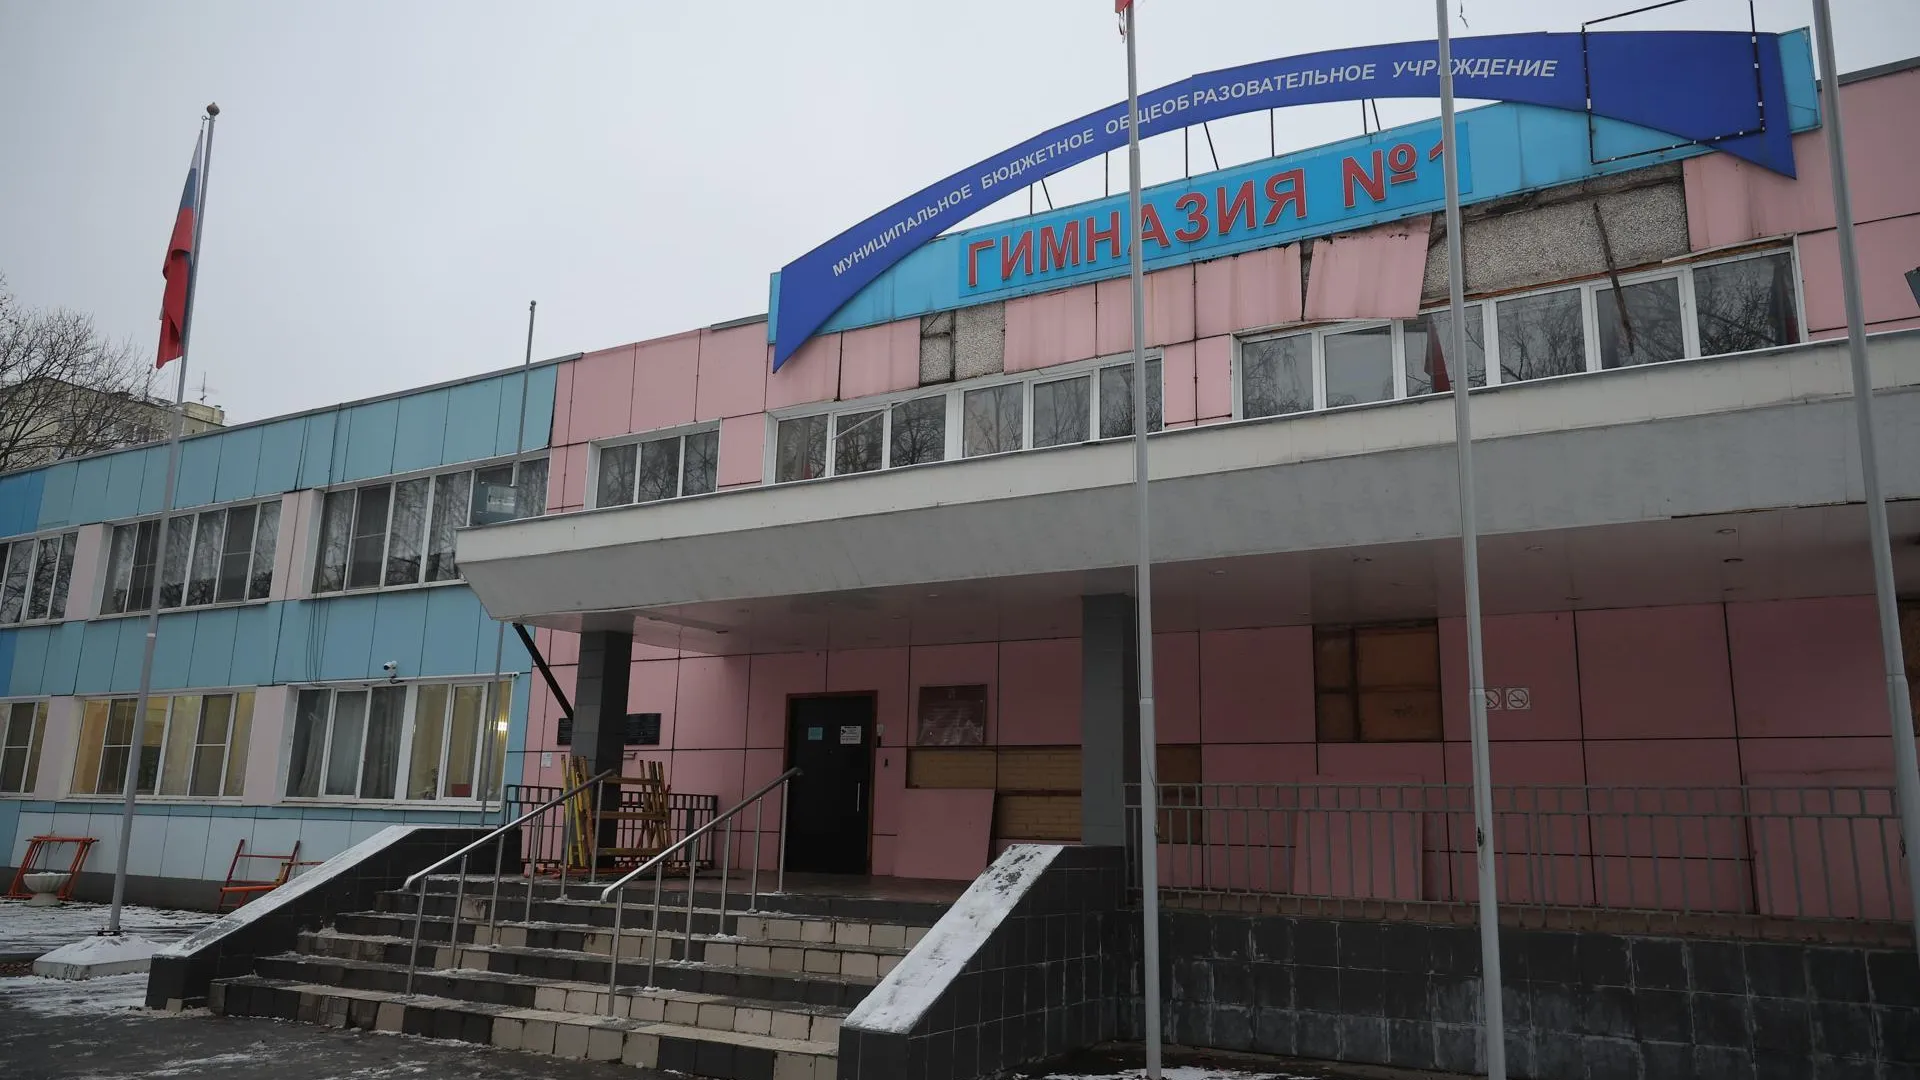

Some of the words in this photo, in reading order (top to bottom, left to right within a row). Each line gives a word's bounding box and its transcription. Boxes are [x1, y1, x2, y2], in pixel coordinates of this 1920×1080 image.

[832, 184, 973, 277] МУНИЦИПАЛЬНОЕ
[981, 128, 1095, 190] БЮДЖЕТНОЕ
[1392, 58, 1558, 79] УЧРЖДЕНИЕ
[967, 168, 1308, 288] ГИМНАЗИЯ
